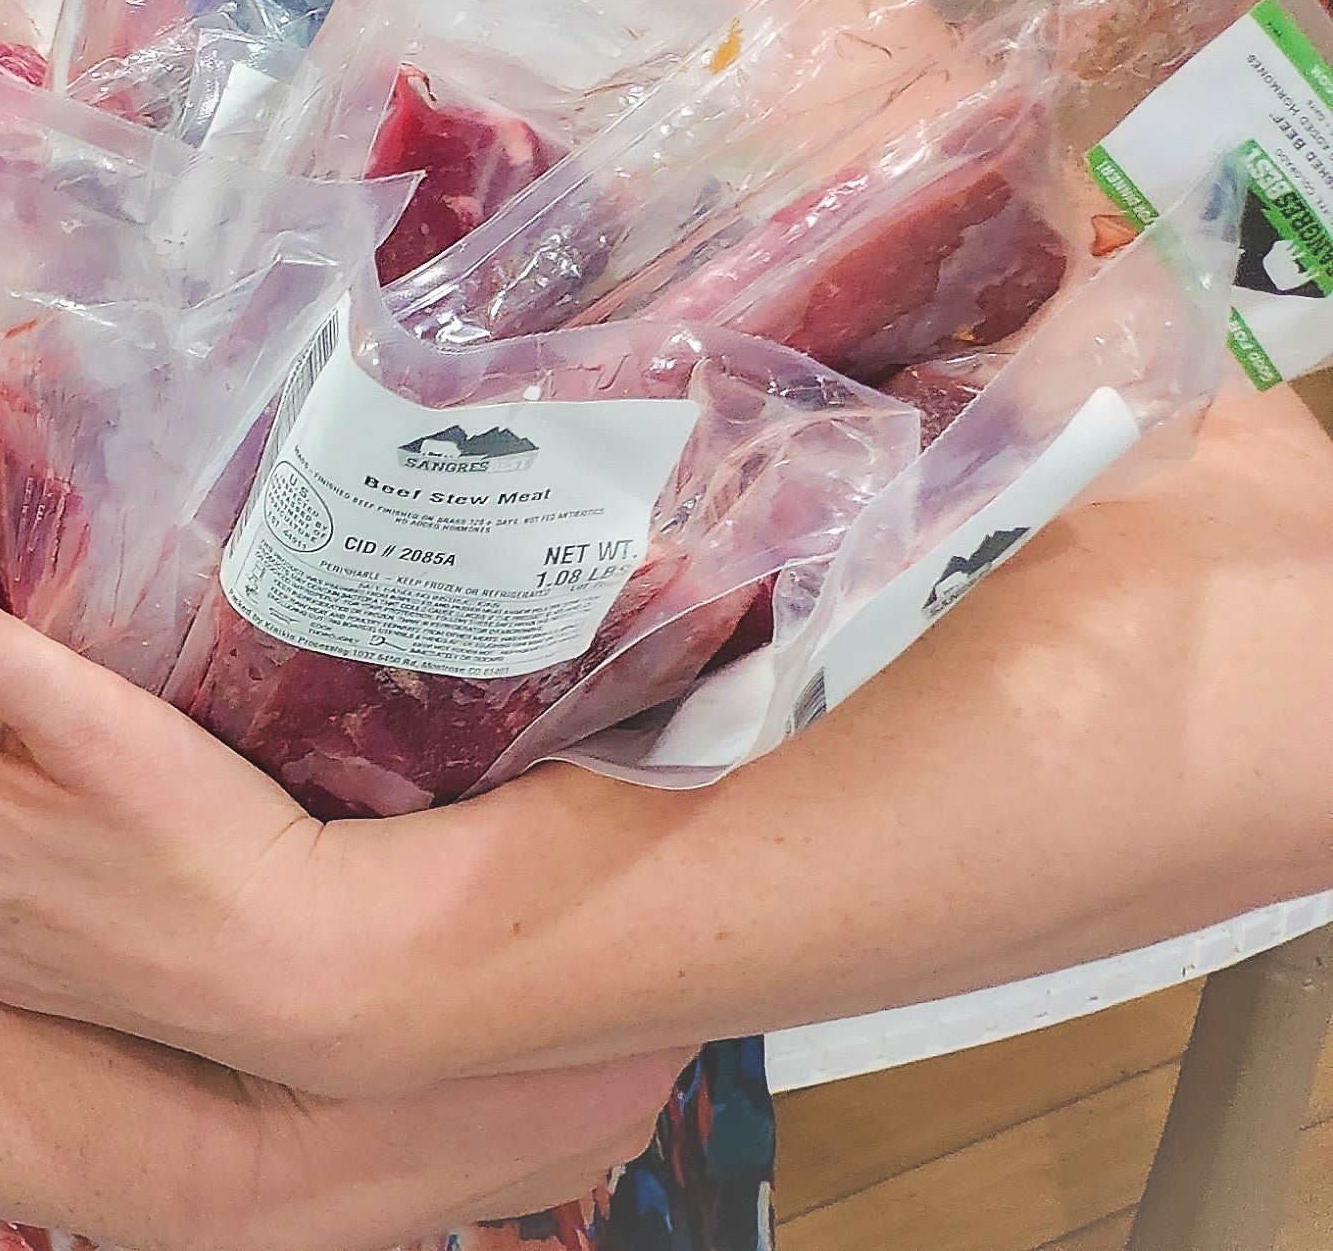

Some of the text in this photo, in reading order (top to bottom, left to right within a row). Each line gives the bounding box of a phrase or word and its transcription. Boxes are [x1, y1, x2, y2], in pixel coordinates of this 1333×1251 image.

[1247, 54, 1301, 116] HORMONES
[404, 457, 490, 473] SANGRES
[363, 475, 552, 505] Beef Stew Meat
[344, 536, 377, 555] CID
[398, 548, 456, 567] 2085A
[543, 539, 637, 566] NET WT.
[319, 560, 380, 581] PERISHABLE
[396, 577, 422, 588] KEEP
[424, 580, 463, 594] FROZEN
[465, 588, 478, 596] OR
[536, 568, 583, 588] 1.08
